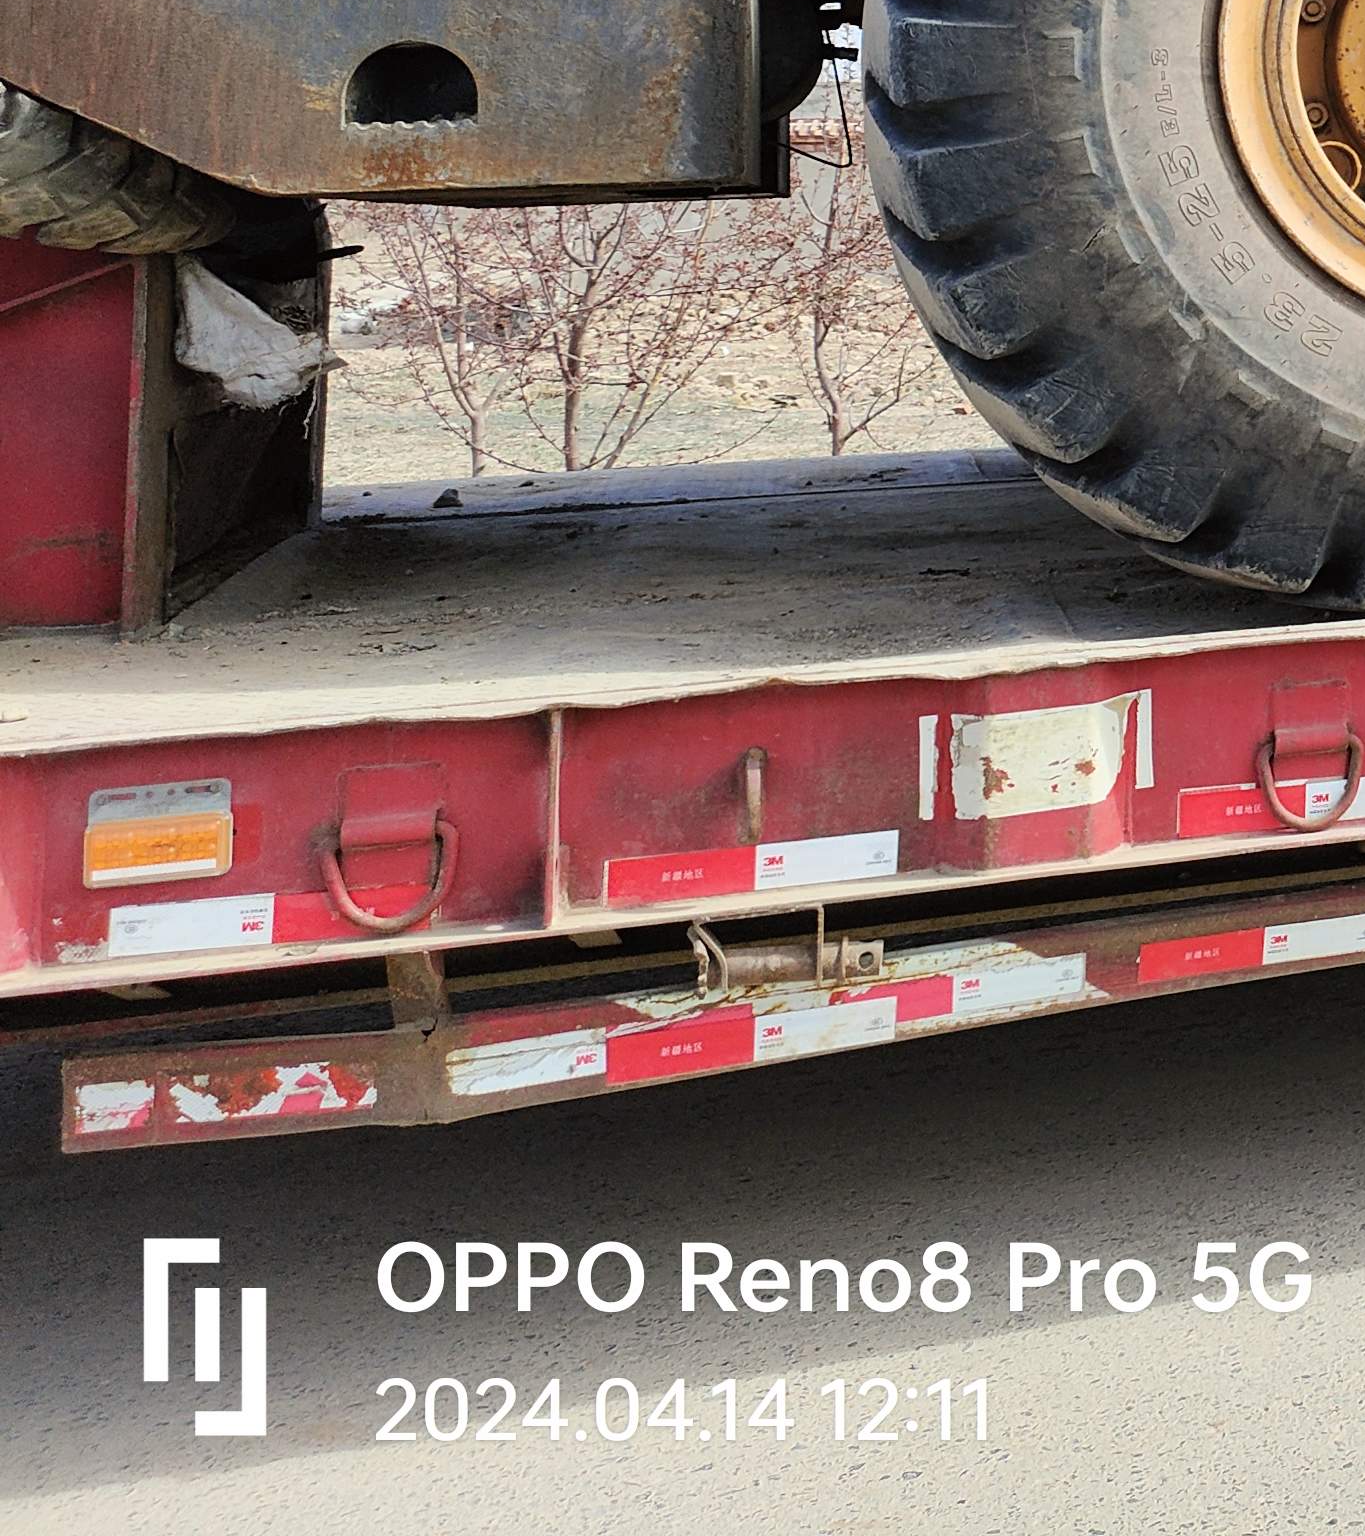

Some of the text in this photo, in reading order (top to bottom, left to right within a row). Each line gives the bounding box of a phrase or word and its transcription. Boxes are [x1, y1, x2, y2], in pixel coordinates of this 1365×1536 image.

[1156, 143, 1344, 359] 23.5-25
[1311, 794, 1330, 804] 3M
[763, 855, 784, 866] 3M
[661, 869, 703, 882] 新疆地区
[242, 921, 264, 932] 3M
[1270, 934, 1288, 944] 3M
[960, 979, 980, 989] 3M
[762, 1026, 783, 1037] 3M
[661, 1042, 702, 1056] 新疆地区
[577, 1053, 597, 1066] 3M
